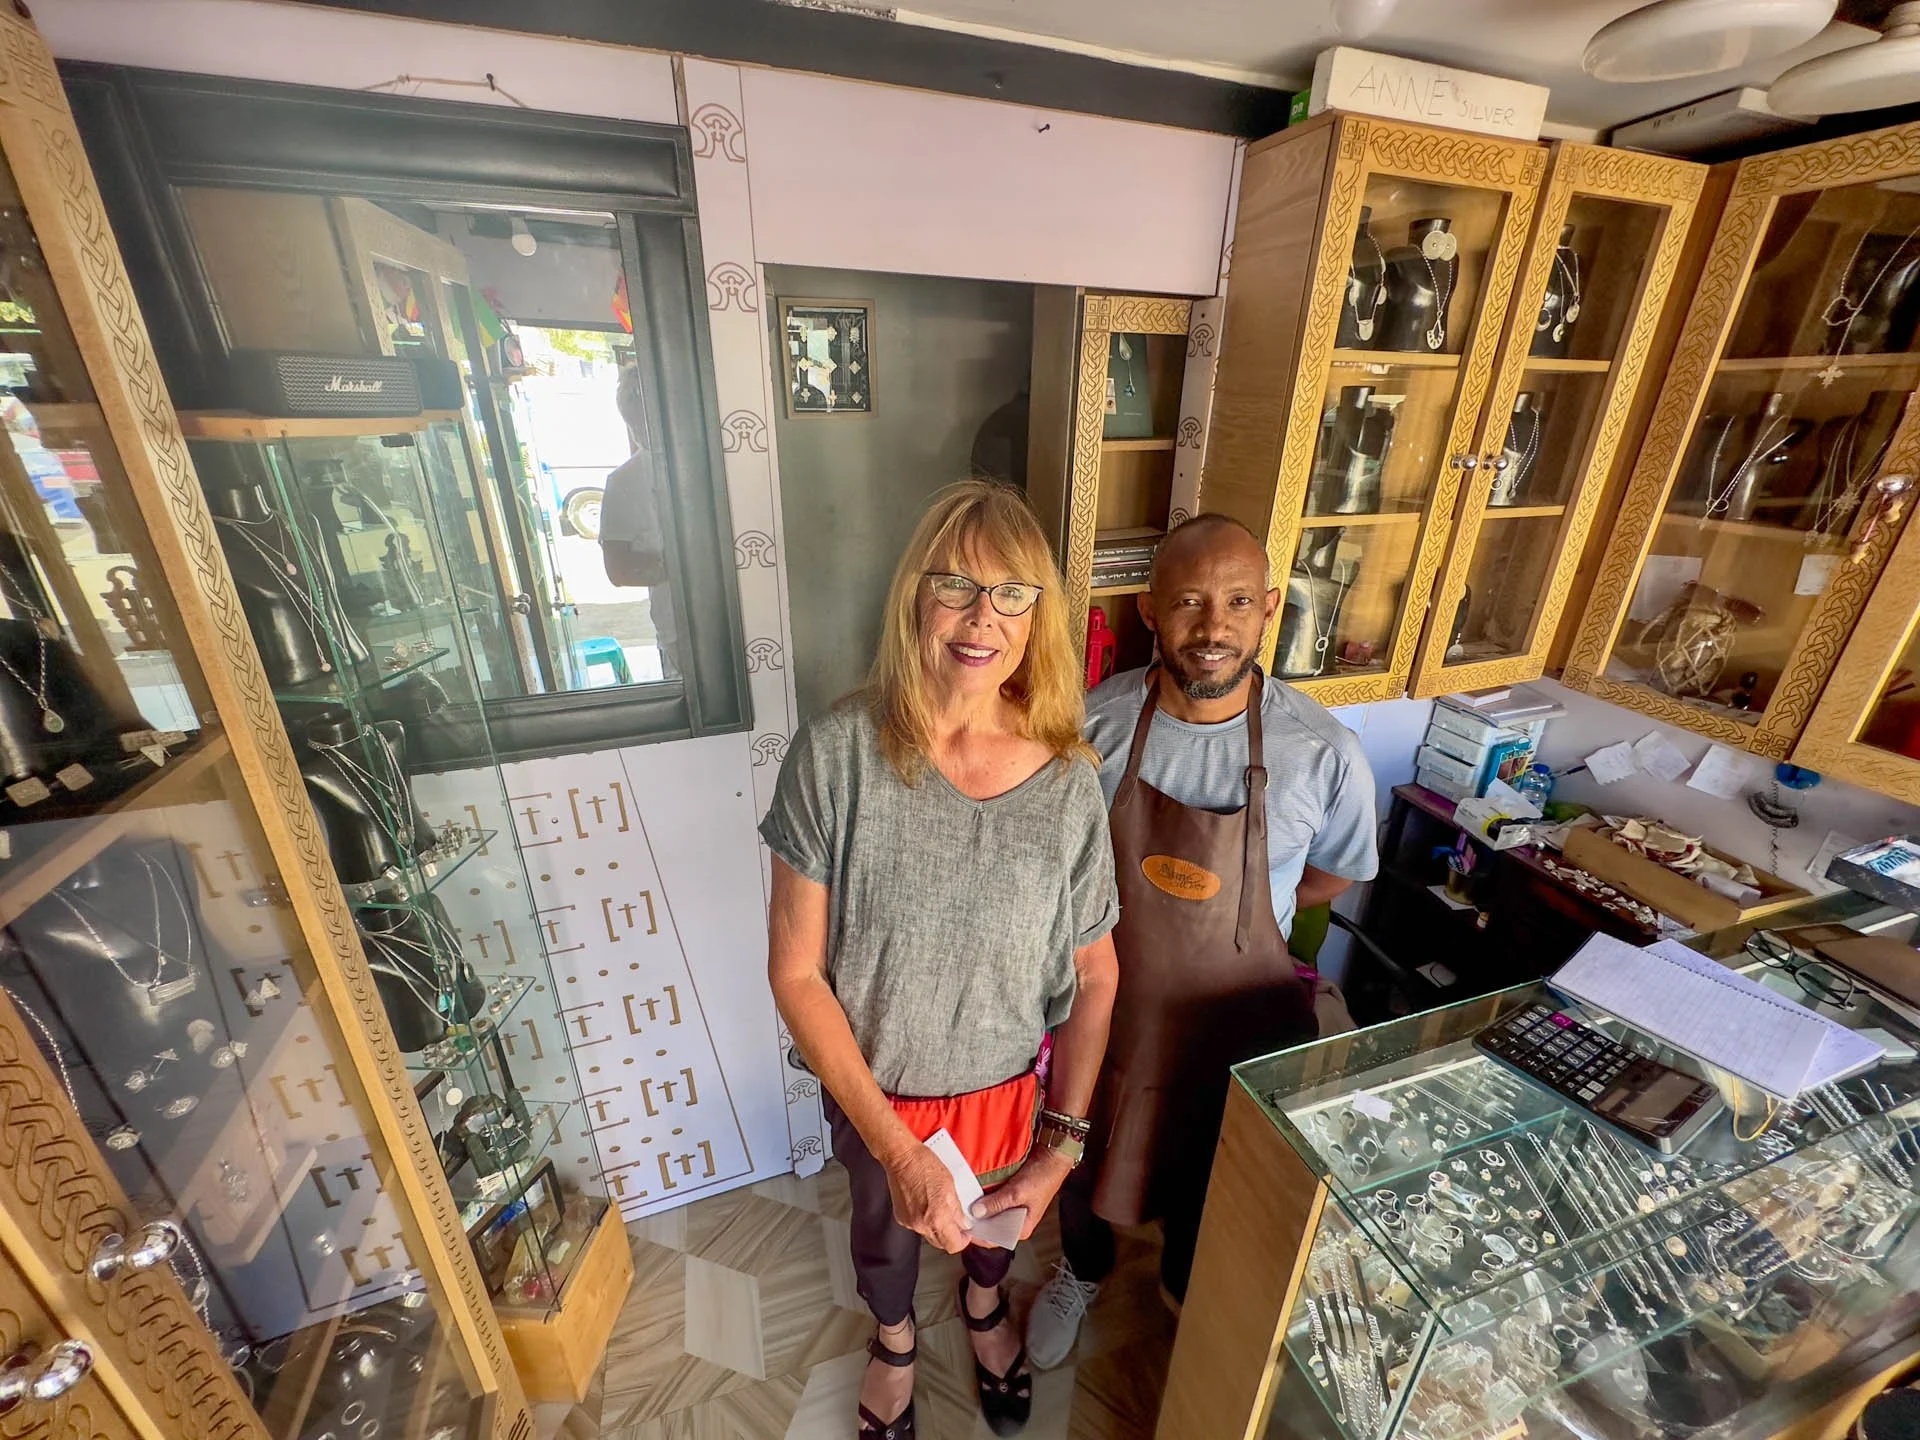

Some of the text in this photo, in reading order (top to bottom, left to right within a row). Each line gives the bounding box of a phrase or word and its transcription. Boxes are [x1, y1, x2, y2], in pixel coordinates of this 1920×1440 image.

[1350, 65, 1515, 127] ANNE SILVER
[325, 375, 383, 392] Marshall
